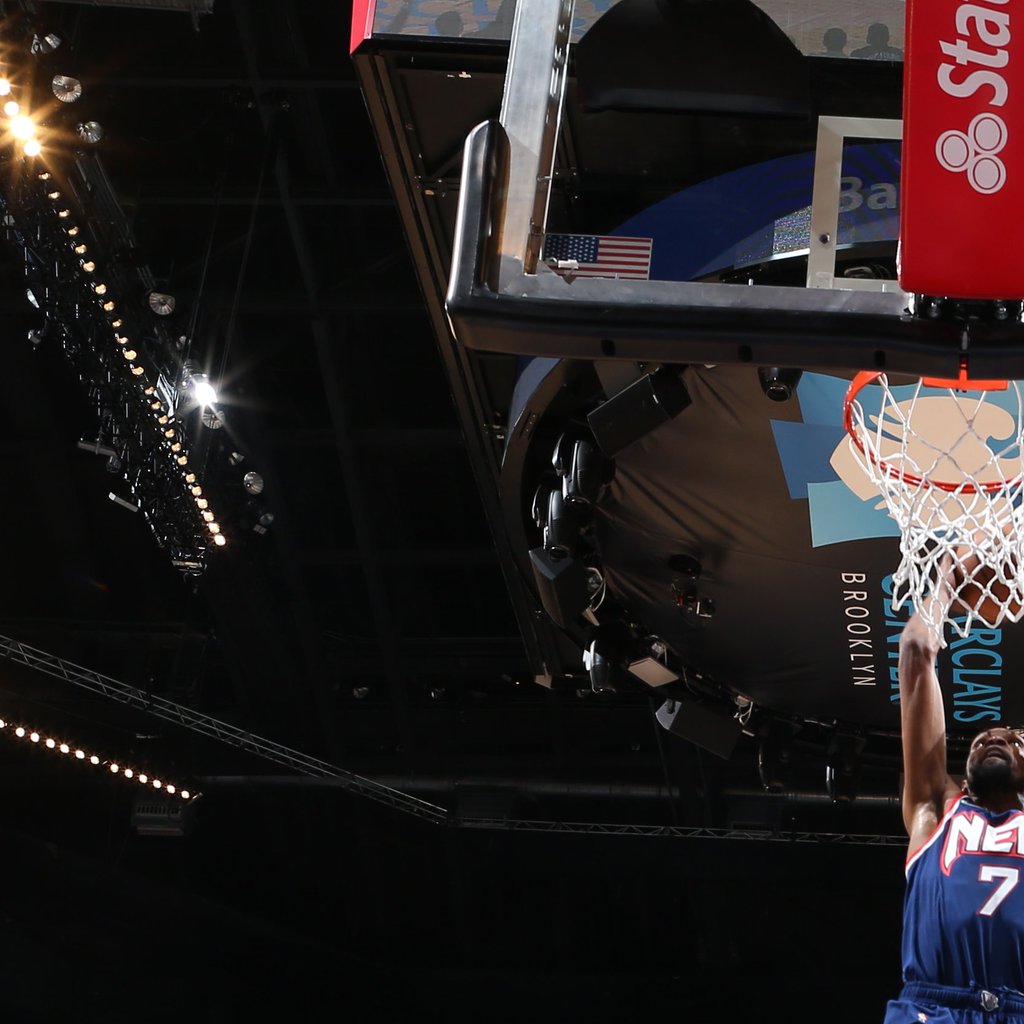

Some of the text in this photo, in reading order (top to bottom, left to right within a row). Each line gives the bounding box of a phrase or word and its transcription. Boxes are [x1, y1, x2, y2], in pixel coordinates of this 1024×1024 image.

[937, 0, 1011, 107] Sta
[841, 572, 877, 687] BROOKLYN
[950, 613, 1003, 723] RCLAYS
[979, 864, 1020, 917] 7
